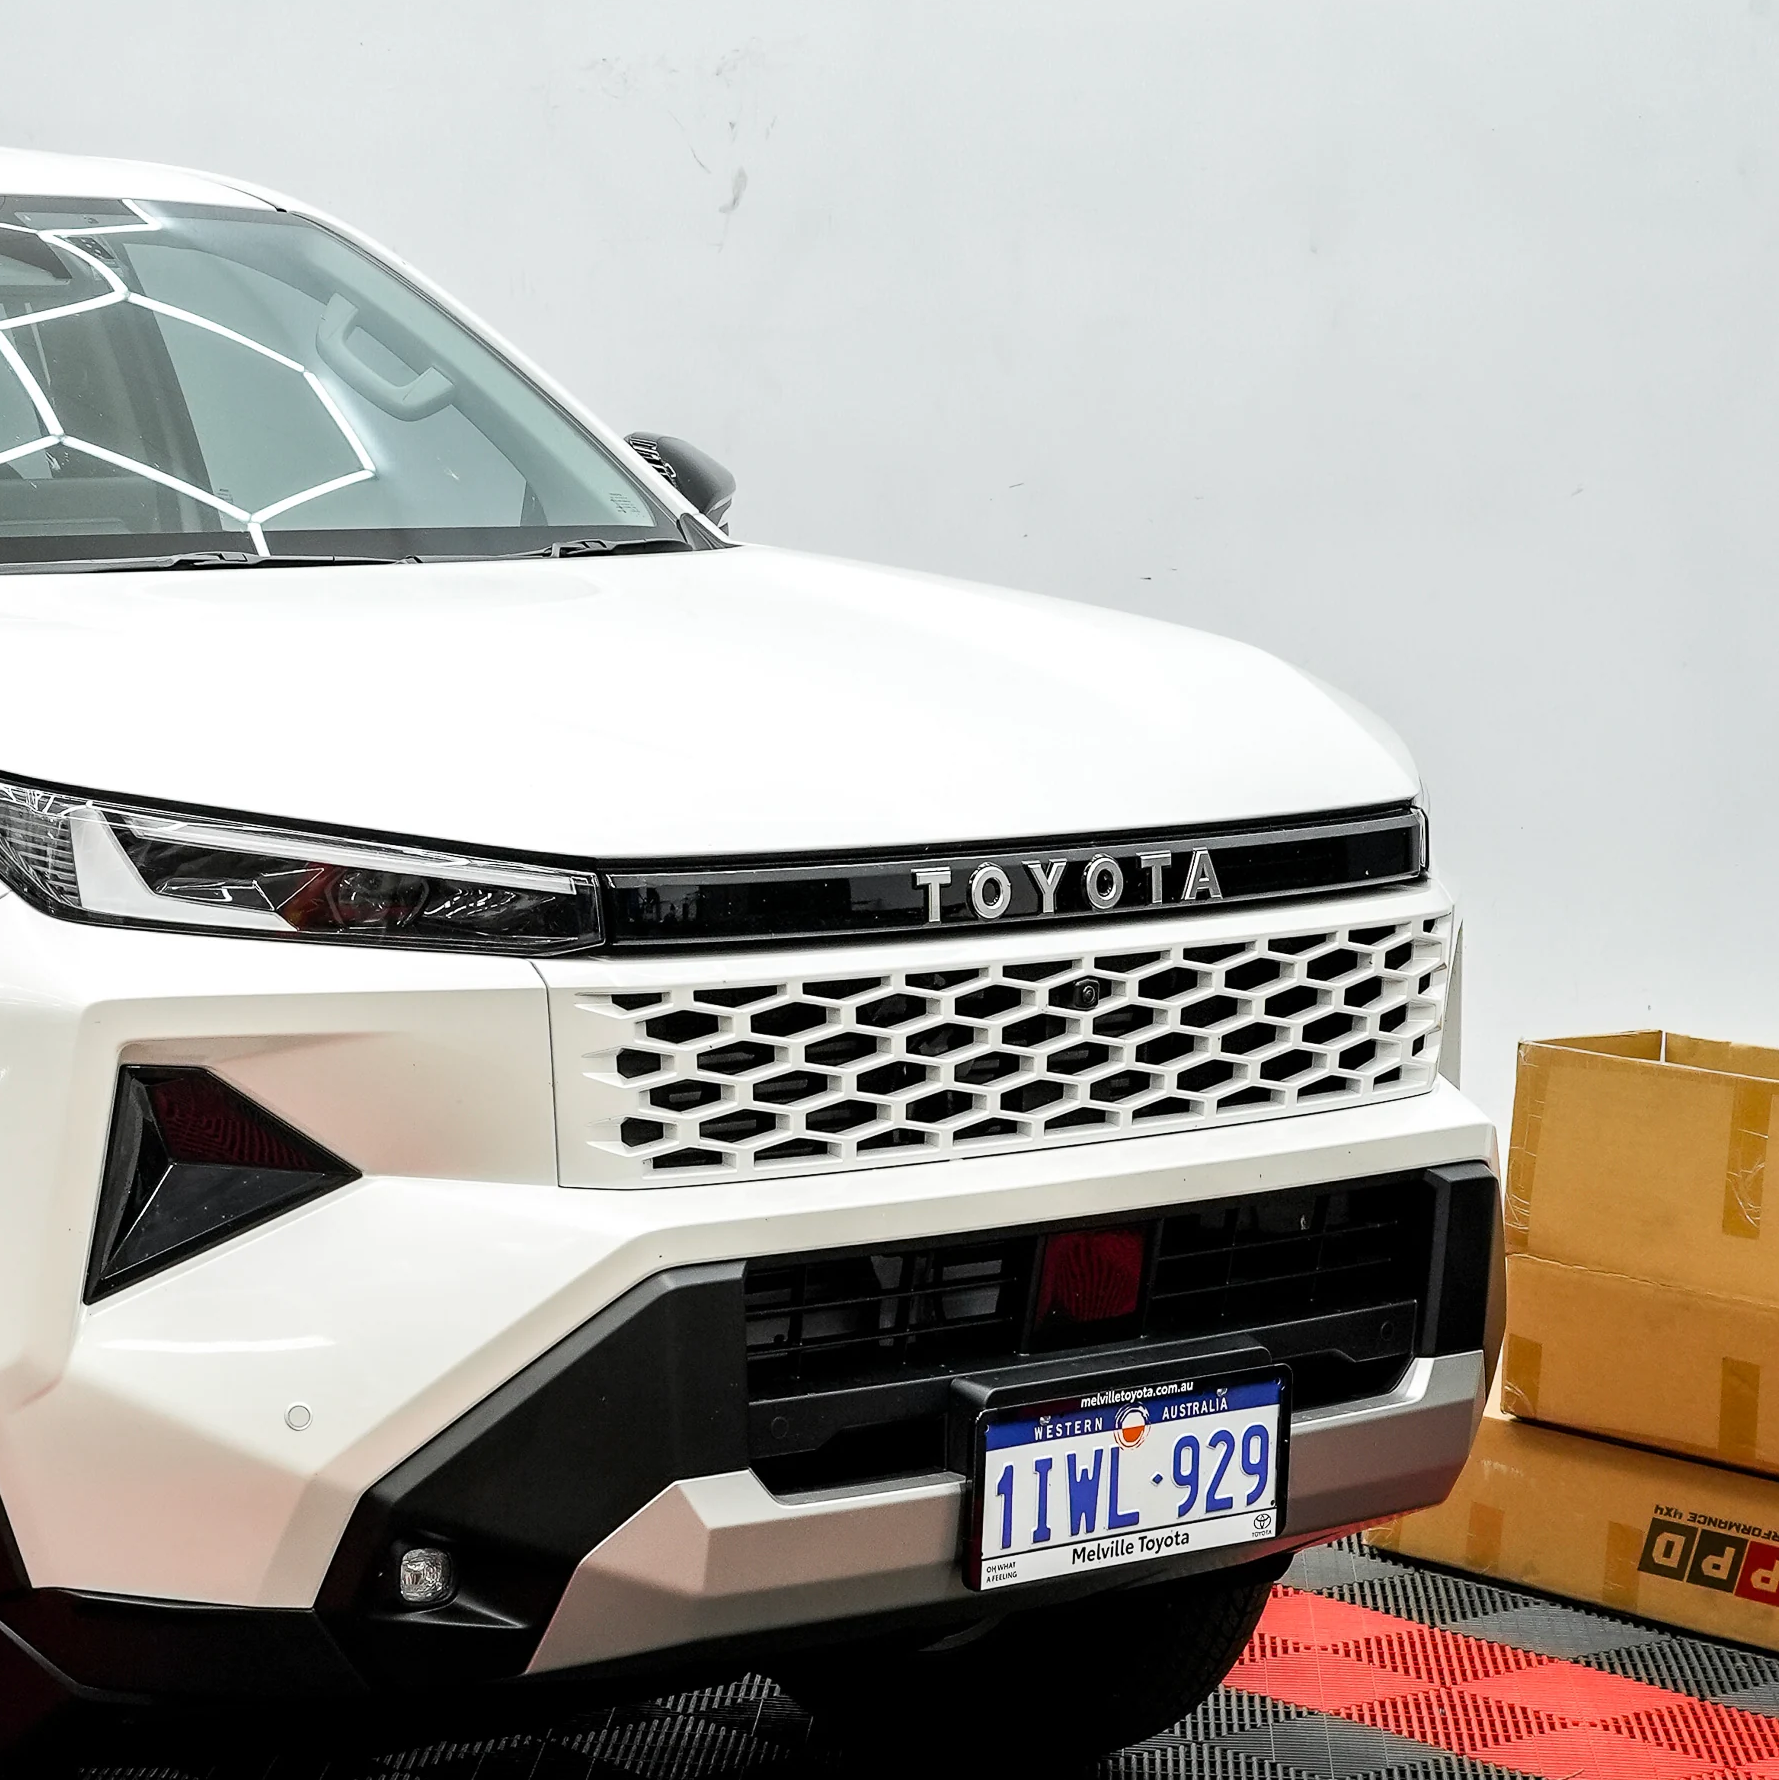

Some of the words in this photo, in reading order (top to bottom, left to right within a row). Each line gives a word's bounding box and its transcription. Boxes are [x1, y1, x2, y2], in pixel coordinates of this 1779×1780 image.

[911, 847, 1223, 922] TOYOTA
[1080, 1380, 1194, 1408] melvilletoyota.com.au
[1034, 1417, 1103, 1441] WESTERN
[1162, 1397, 1229, 1421] AUSTRALIA
[1654, 1504, 1683, 1520] 4X4
[1071, 1538, 1134, 1565] Melville
[1138, 1529, 1190, 1558] Toyota
[992, 1571, 1018, 1582] FEELING
[997, 1561, 1016, 1571] WHAT
